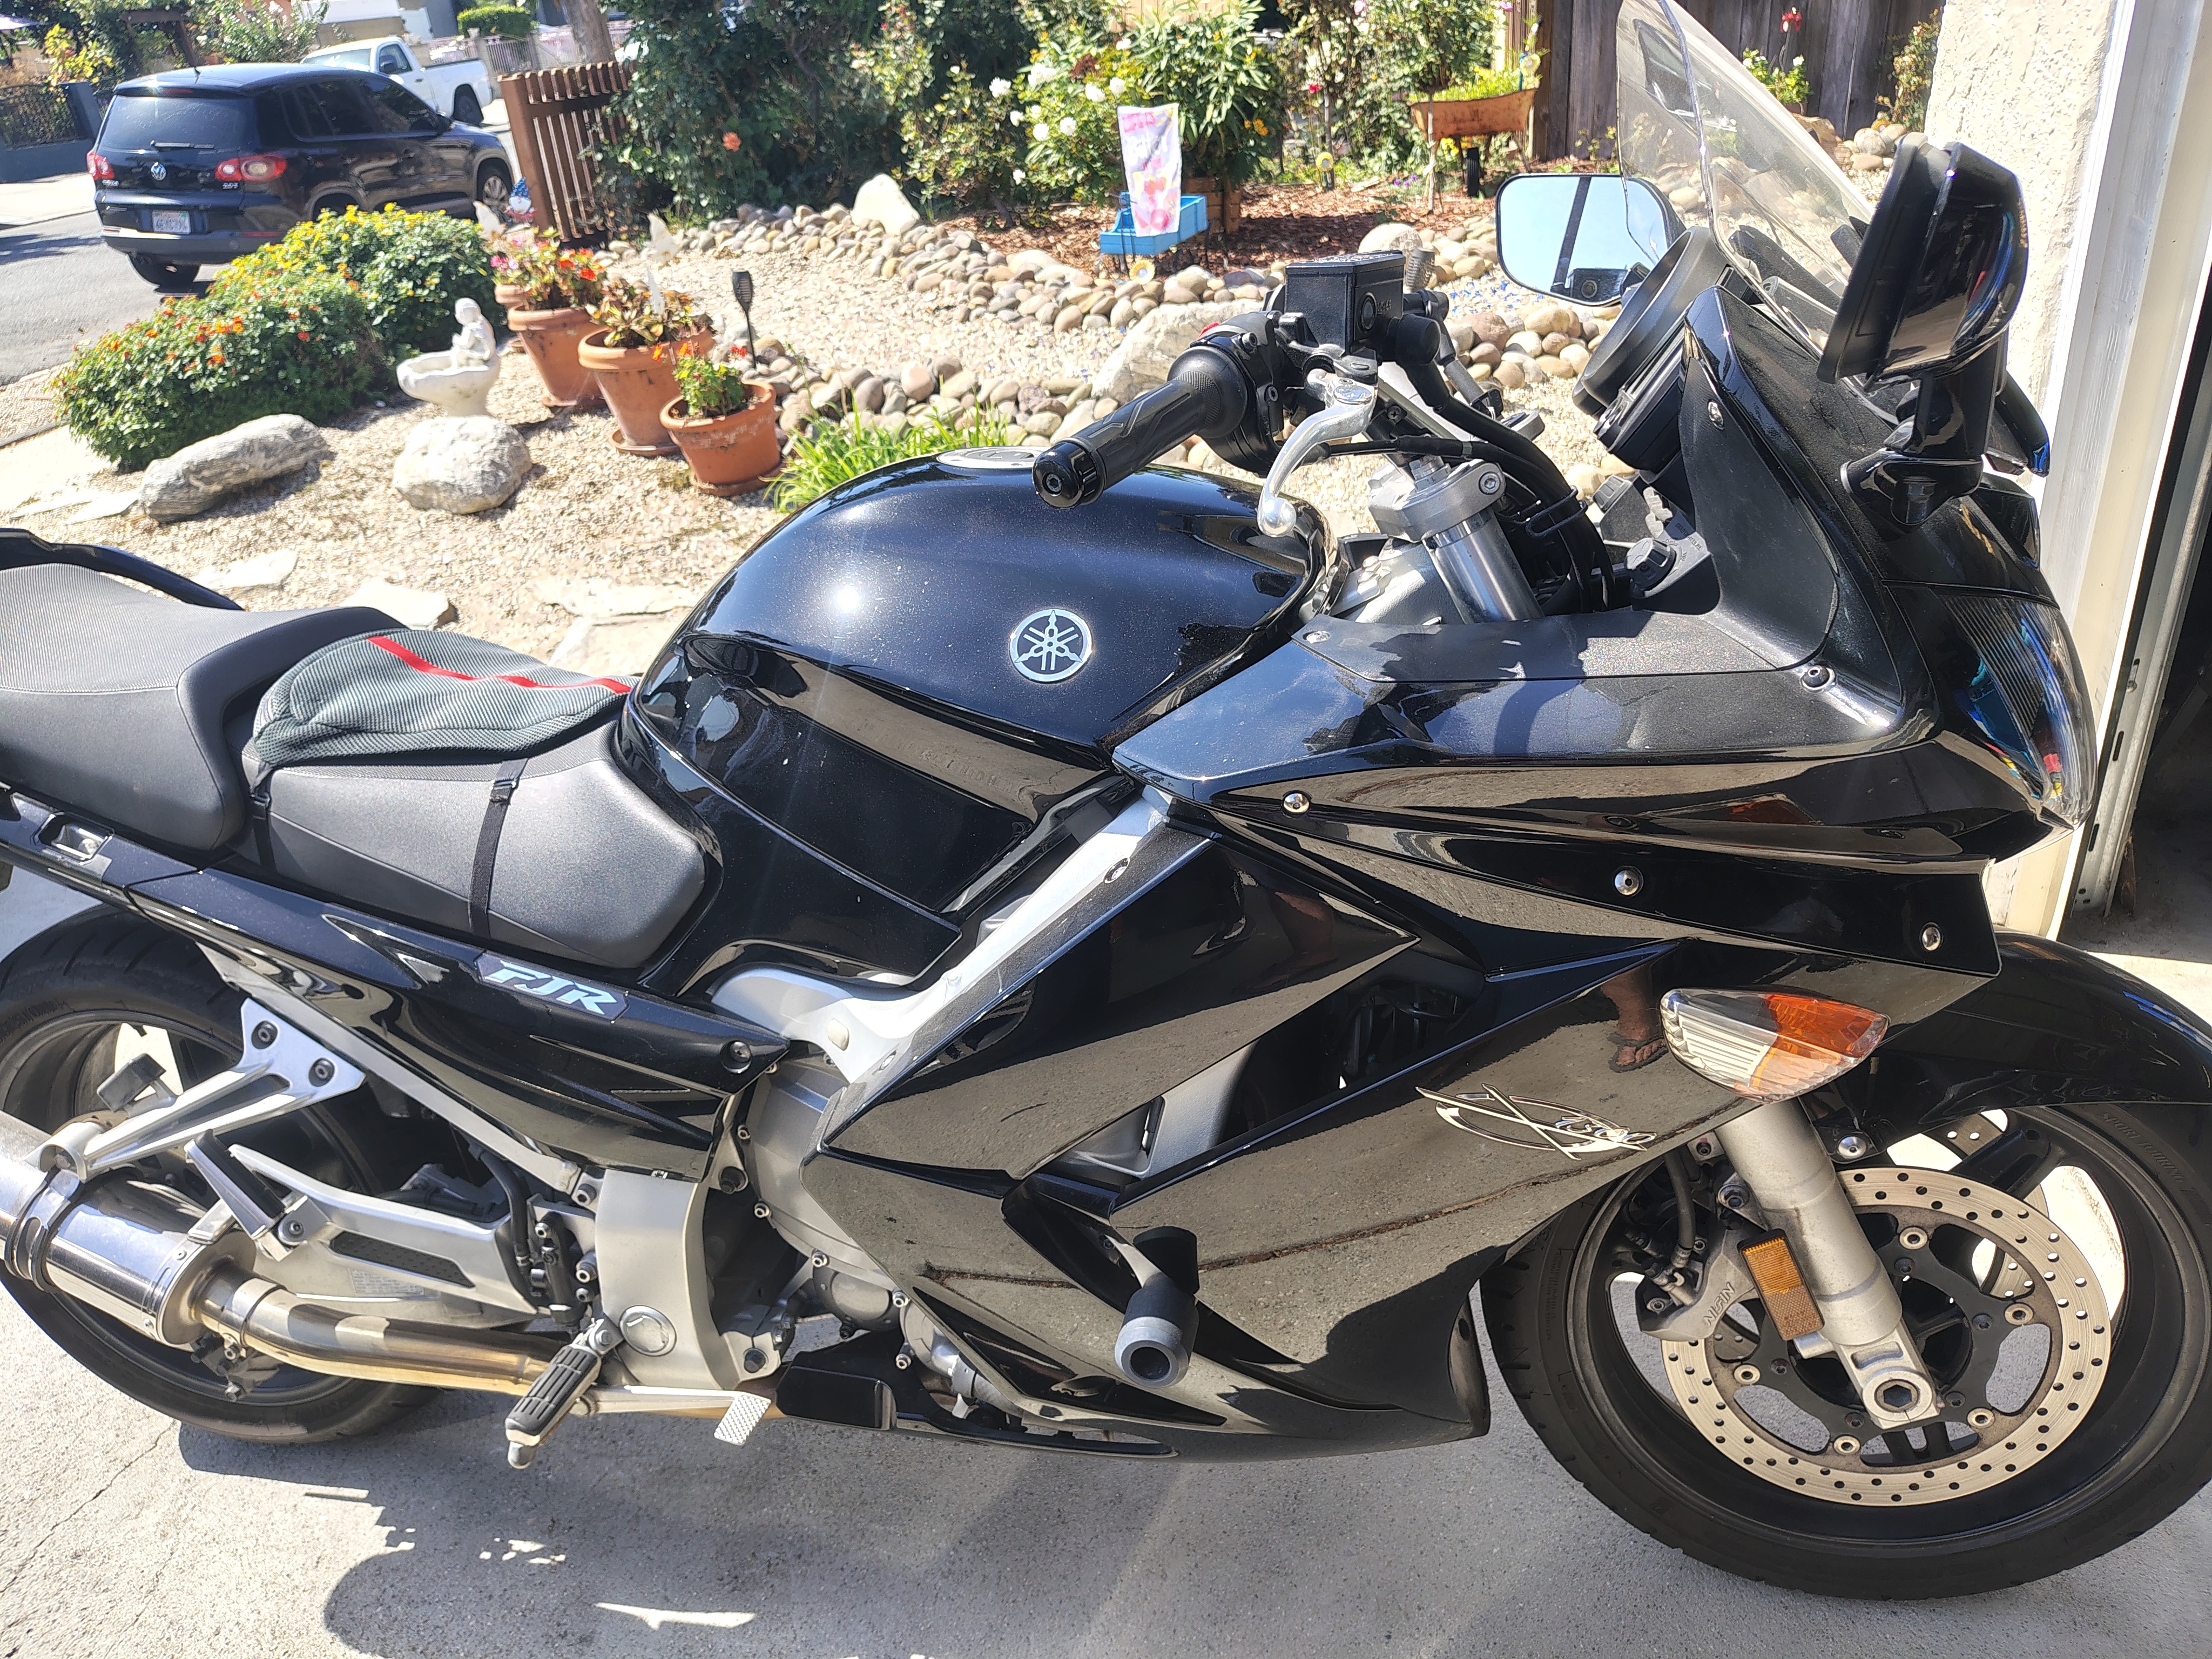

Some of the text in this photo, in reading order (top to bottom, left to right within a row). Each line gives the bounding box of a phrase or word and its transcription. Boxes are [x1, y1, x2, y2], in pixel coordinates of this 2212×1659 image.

[484, 960, 618, 1015] FJR
[2098, 1111, 2143, 1139] SPORT
[1703, 1282, 1736, 1327] NISSIN
